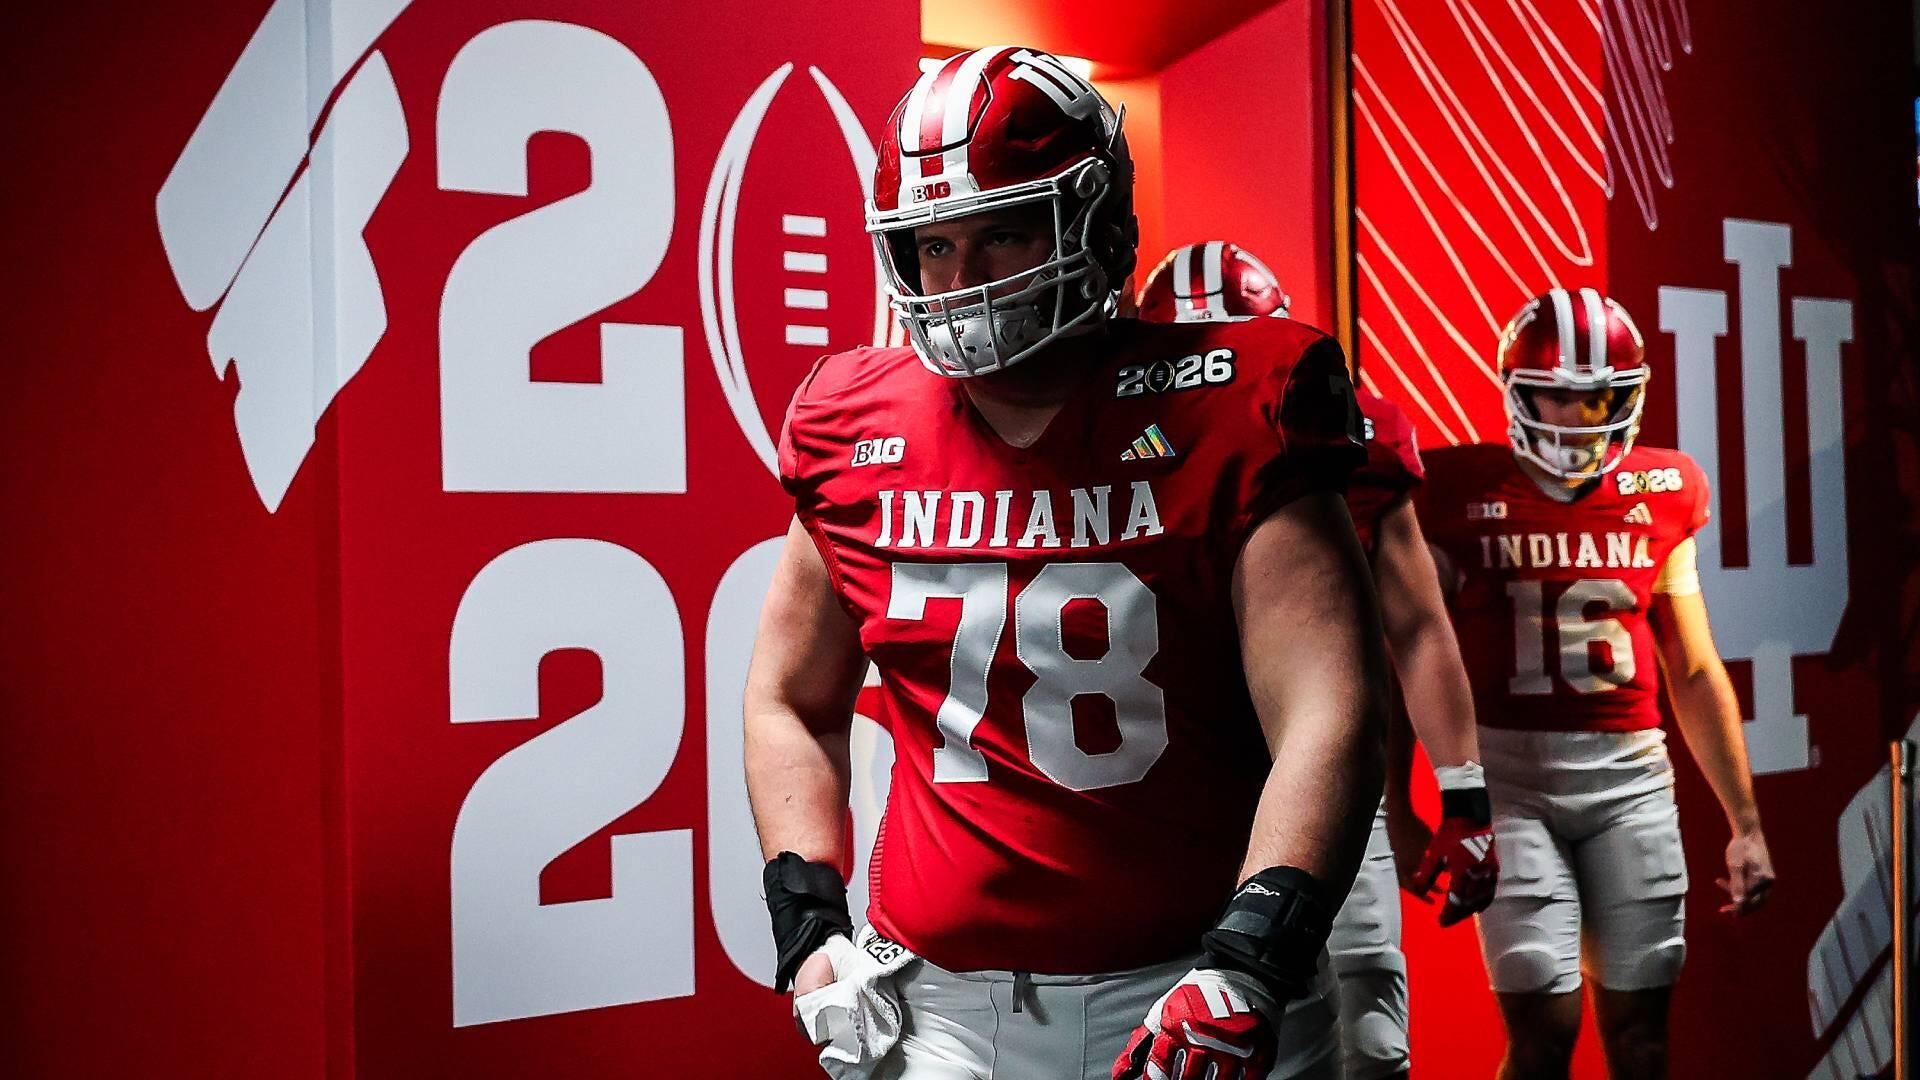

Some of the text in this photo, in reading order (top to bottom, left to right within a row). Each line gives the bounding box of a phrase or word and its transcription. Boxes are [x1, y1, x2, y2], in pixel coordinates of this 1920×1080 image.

[1116, 348, 1234, 398] 2026
[873, 480, 1166, 549] INDIANA
[1480, 531, 1656, 568] INDIANA
[1505, 578, 1638, 695] 16
[886, 561, 1170, 792] 78
